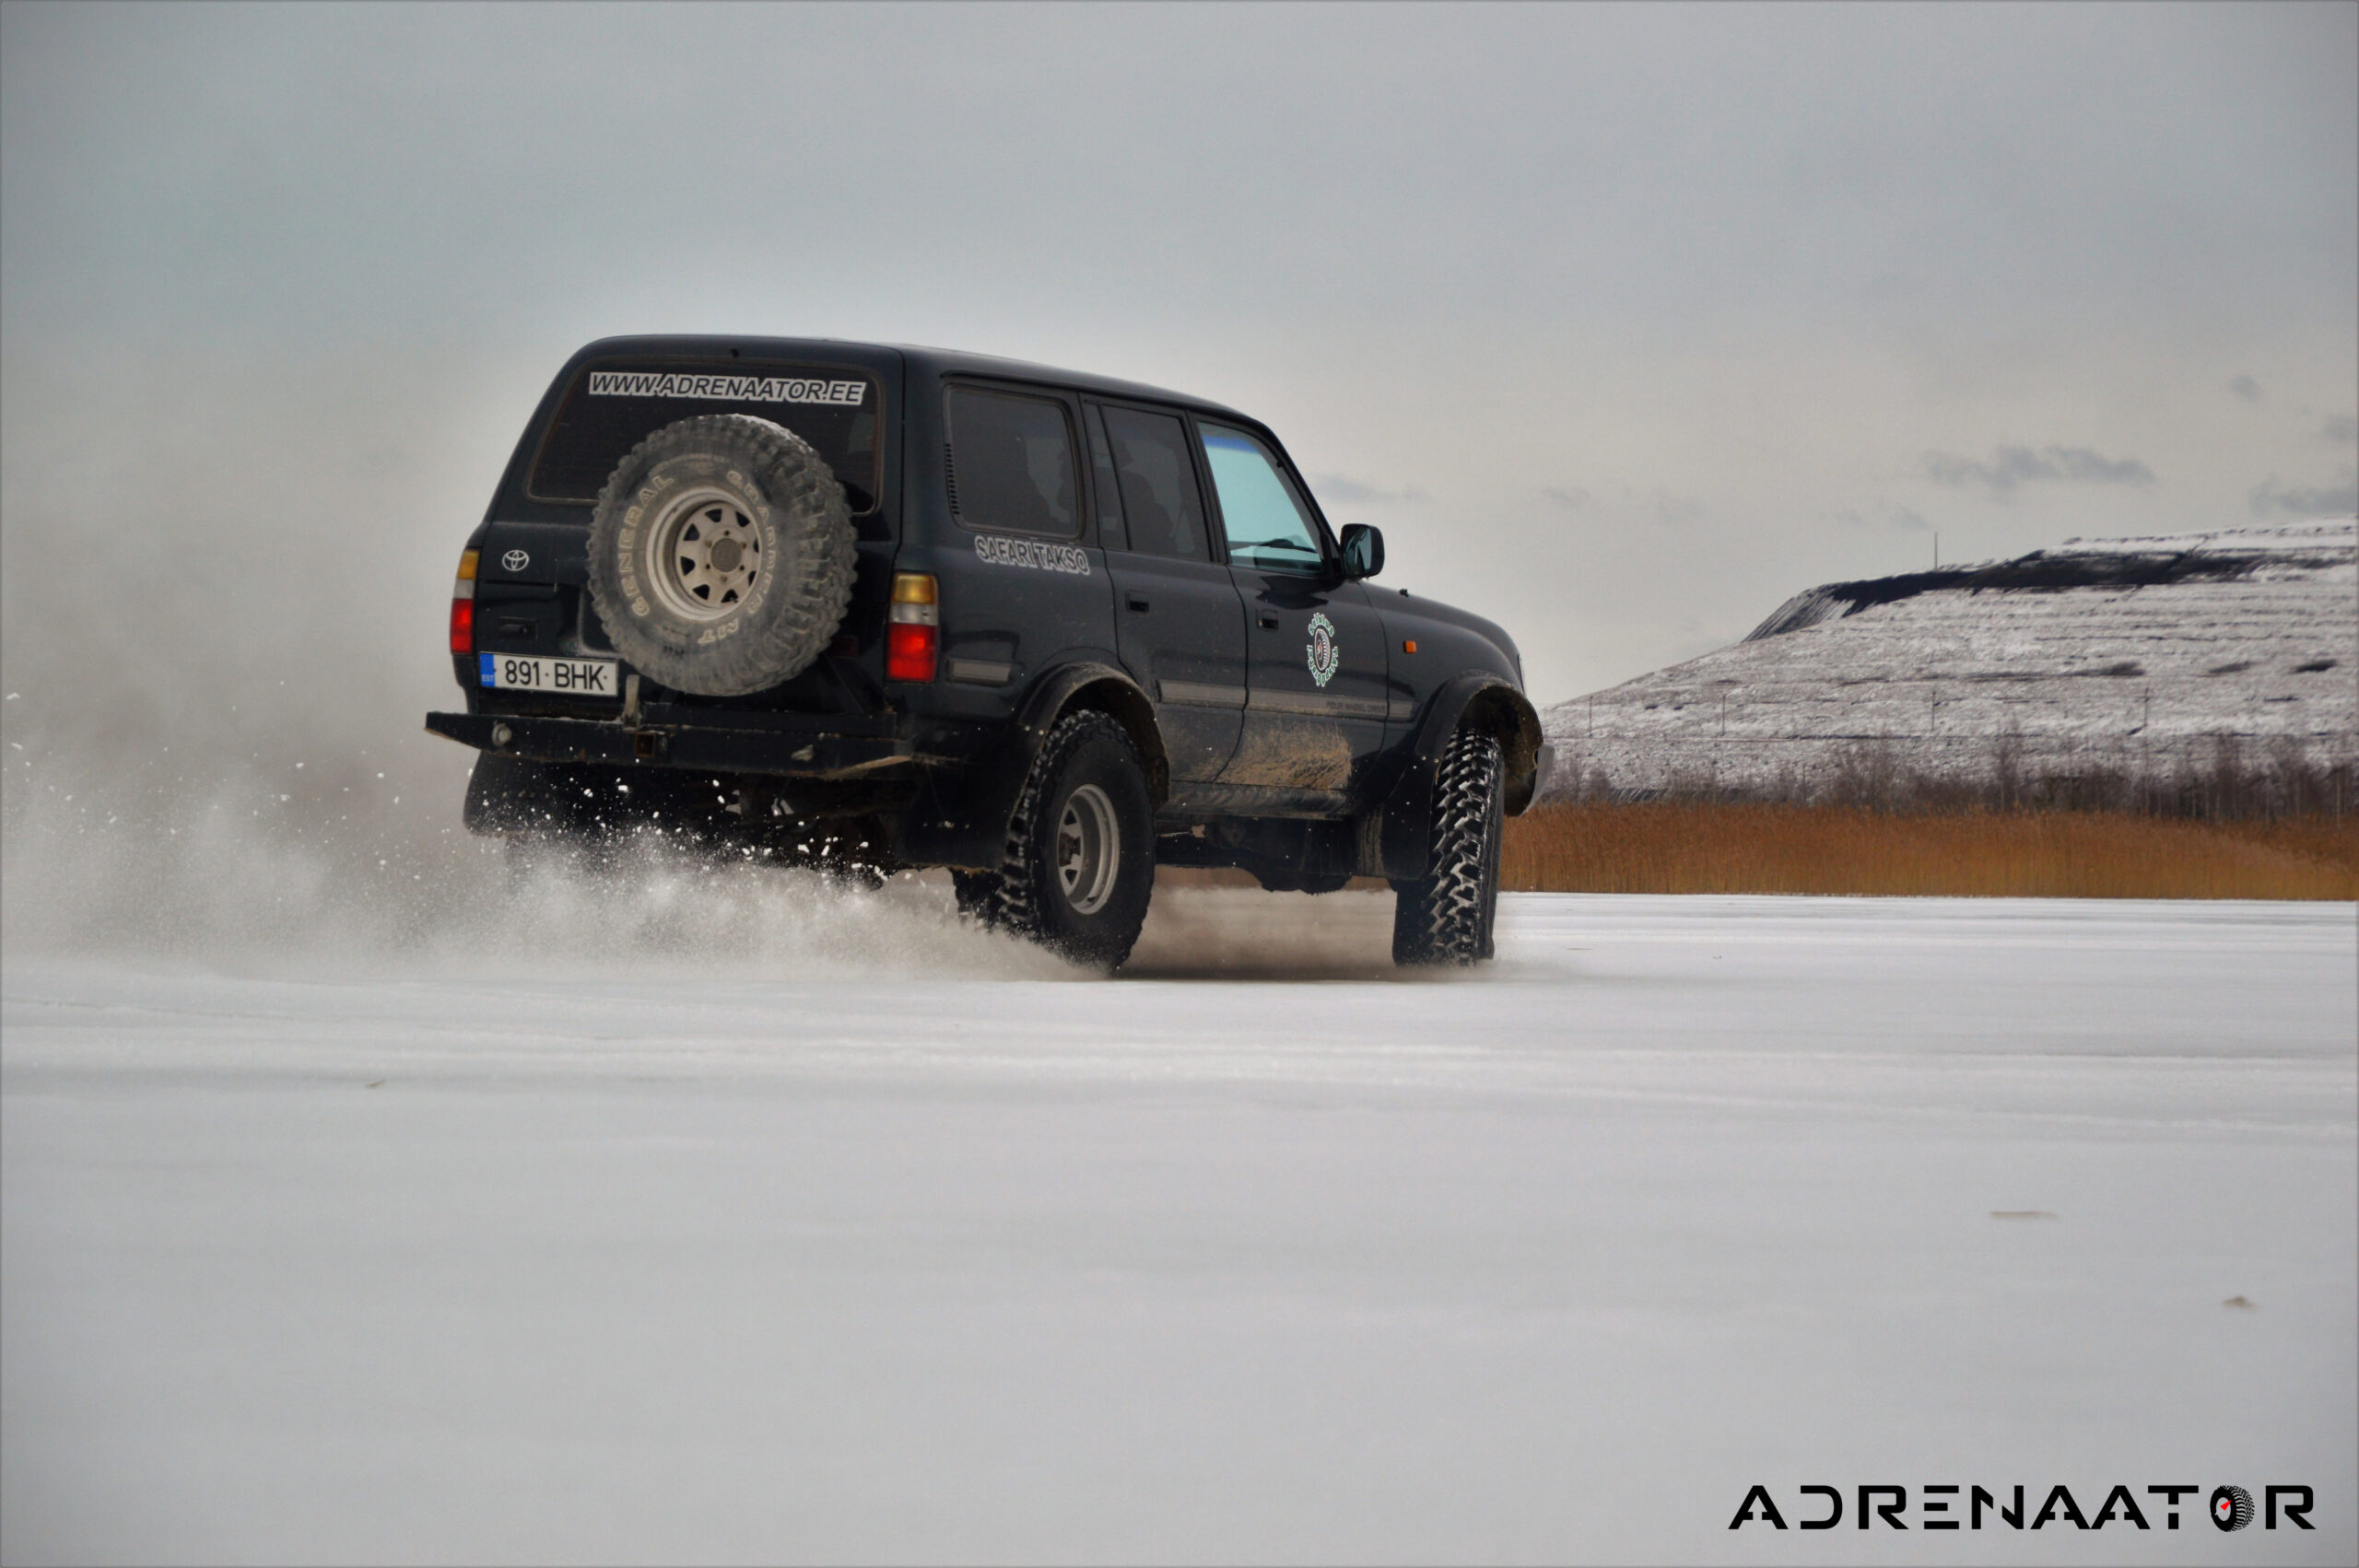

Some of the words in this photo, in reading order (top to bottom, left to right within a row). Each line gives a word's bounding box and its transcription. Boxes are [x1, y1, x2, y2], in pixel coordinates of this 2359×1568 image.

[591, 373, 865, 404] WWW.ADRENAATOR.EE
[618, 475, 674, 616] GENERAL
[975, 535, 1036, 568] SAFARI
[1033, 543, 1090, 575] TAKSO
[481, 673, 495, 683] EST
[505, 660, 540, 686] 891
[555, 662, 604, 690] BHK
